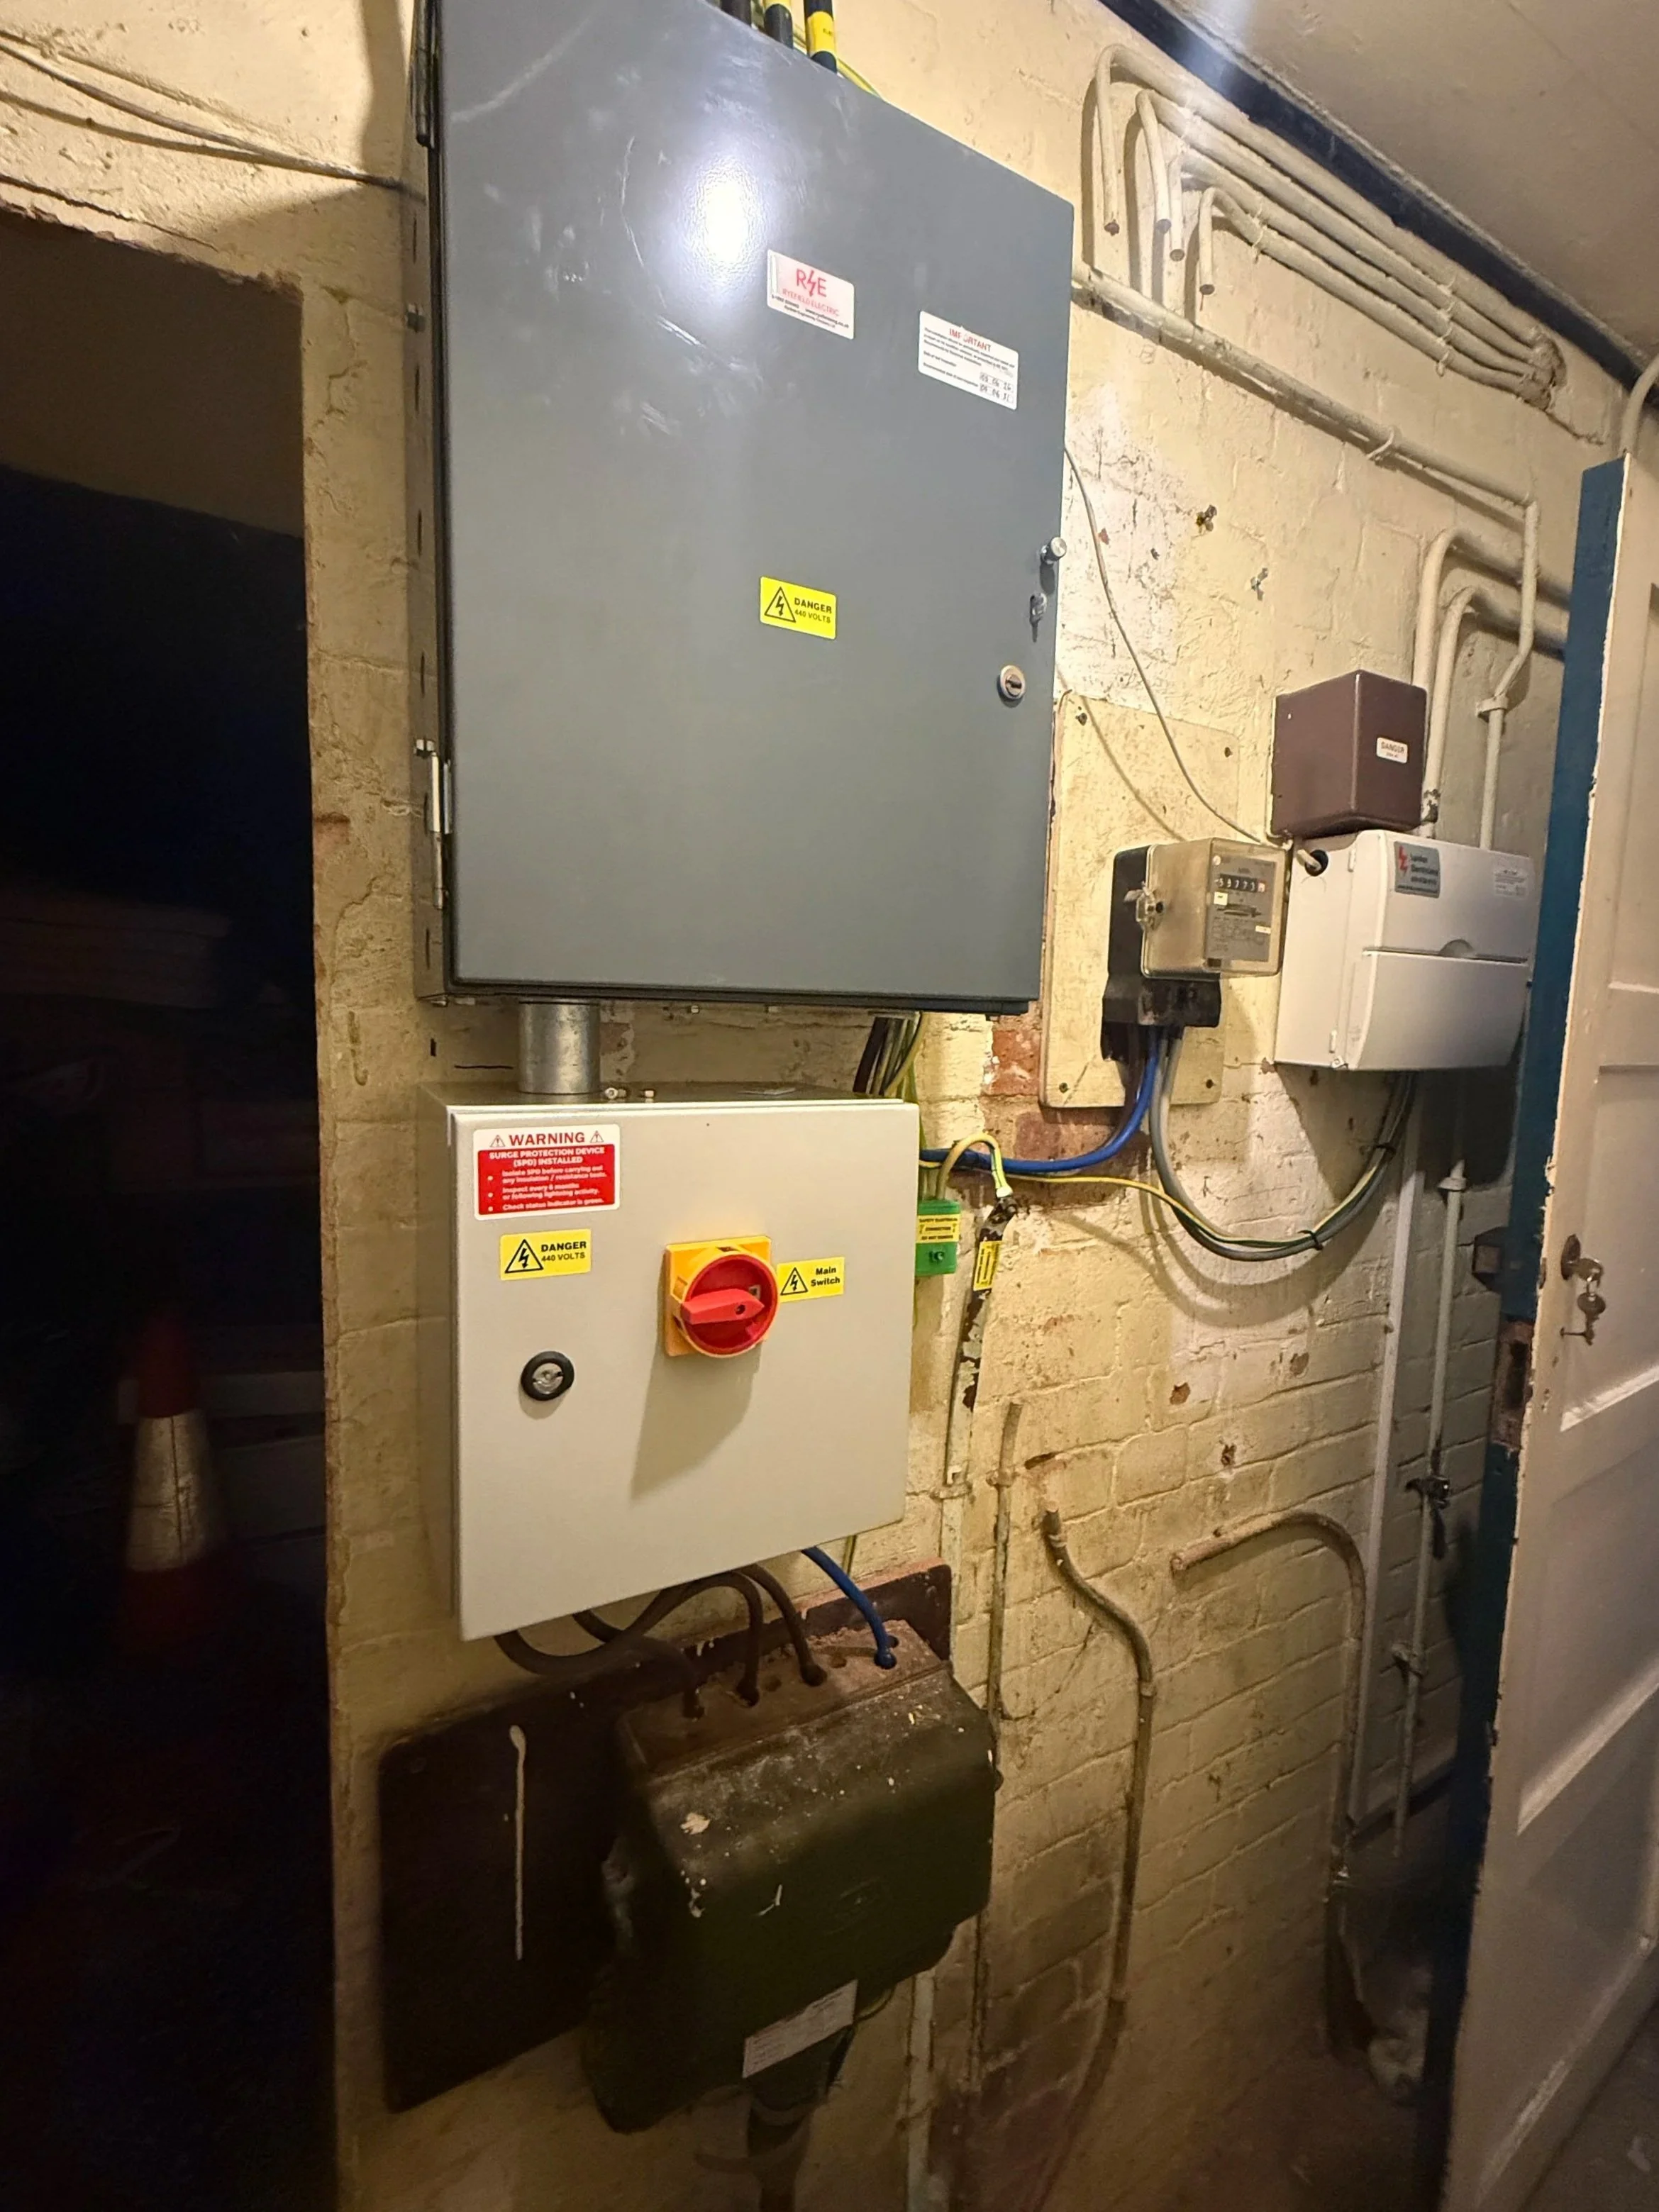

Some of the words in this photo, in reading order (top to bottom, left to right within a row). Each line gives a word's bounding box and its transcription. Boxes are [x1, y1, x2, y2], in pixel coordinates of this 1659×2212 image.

[794, 597, 832, 614] DANGER
[794, 609, 806, 618] 440
[808, 612, 831, 624] VOLTS
[1381, 741, 1404, 754] DANGER
[509, 1132, 585, 1146] WARNING
[489, 1151, 519, 1160] SURGE
[520, 1148, 574, 1158] PROTECTION
[575, 1147, 605, 1155] DEVICE
[514, 1158, 537, 1168] (SPD)
[538, 1157, 583, 1166] INSTALLED
[541, 1241, 587, 1252] DANGER
[557, 1252, 585, 1261] VOLTS
[816, 1266, 836, 1275] Main
[811, 1276, 840, 1287] Switch
